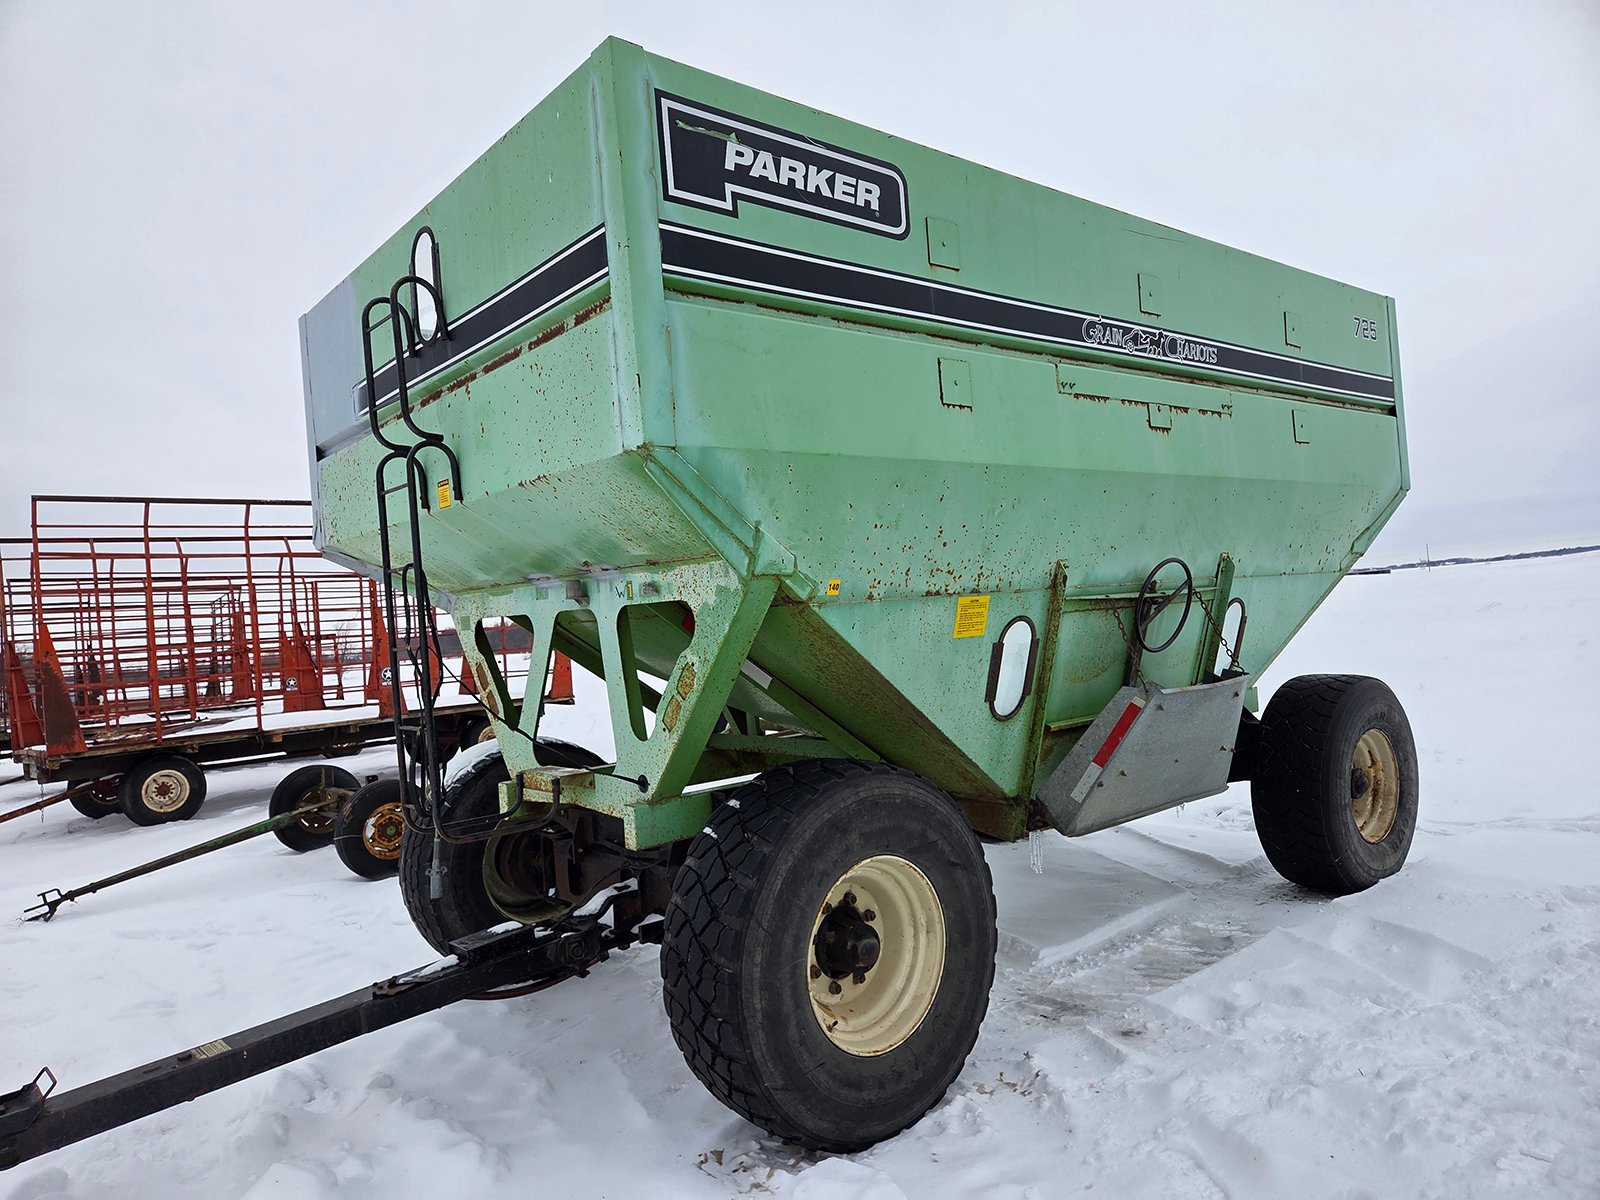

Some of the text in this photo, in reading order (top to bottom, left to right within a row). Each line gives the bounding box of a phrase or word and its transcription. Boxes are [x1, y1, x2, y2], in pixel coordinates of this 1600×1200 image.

[724, 140, 881, 212] PARKER
[1082, 316, 1218, 363] GRAIN CHARIOTS
[1353, 316, 1377, 341] 725
